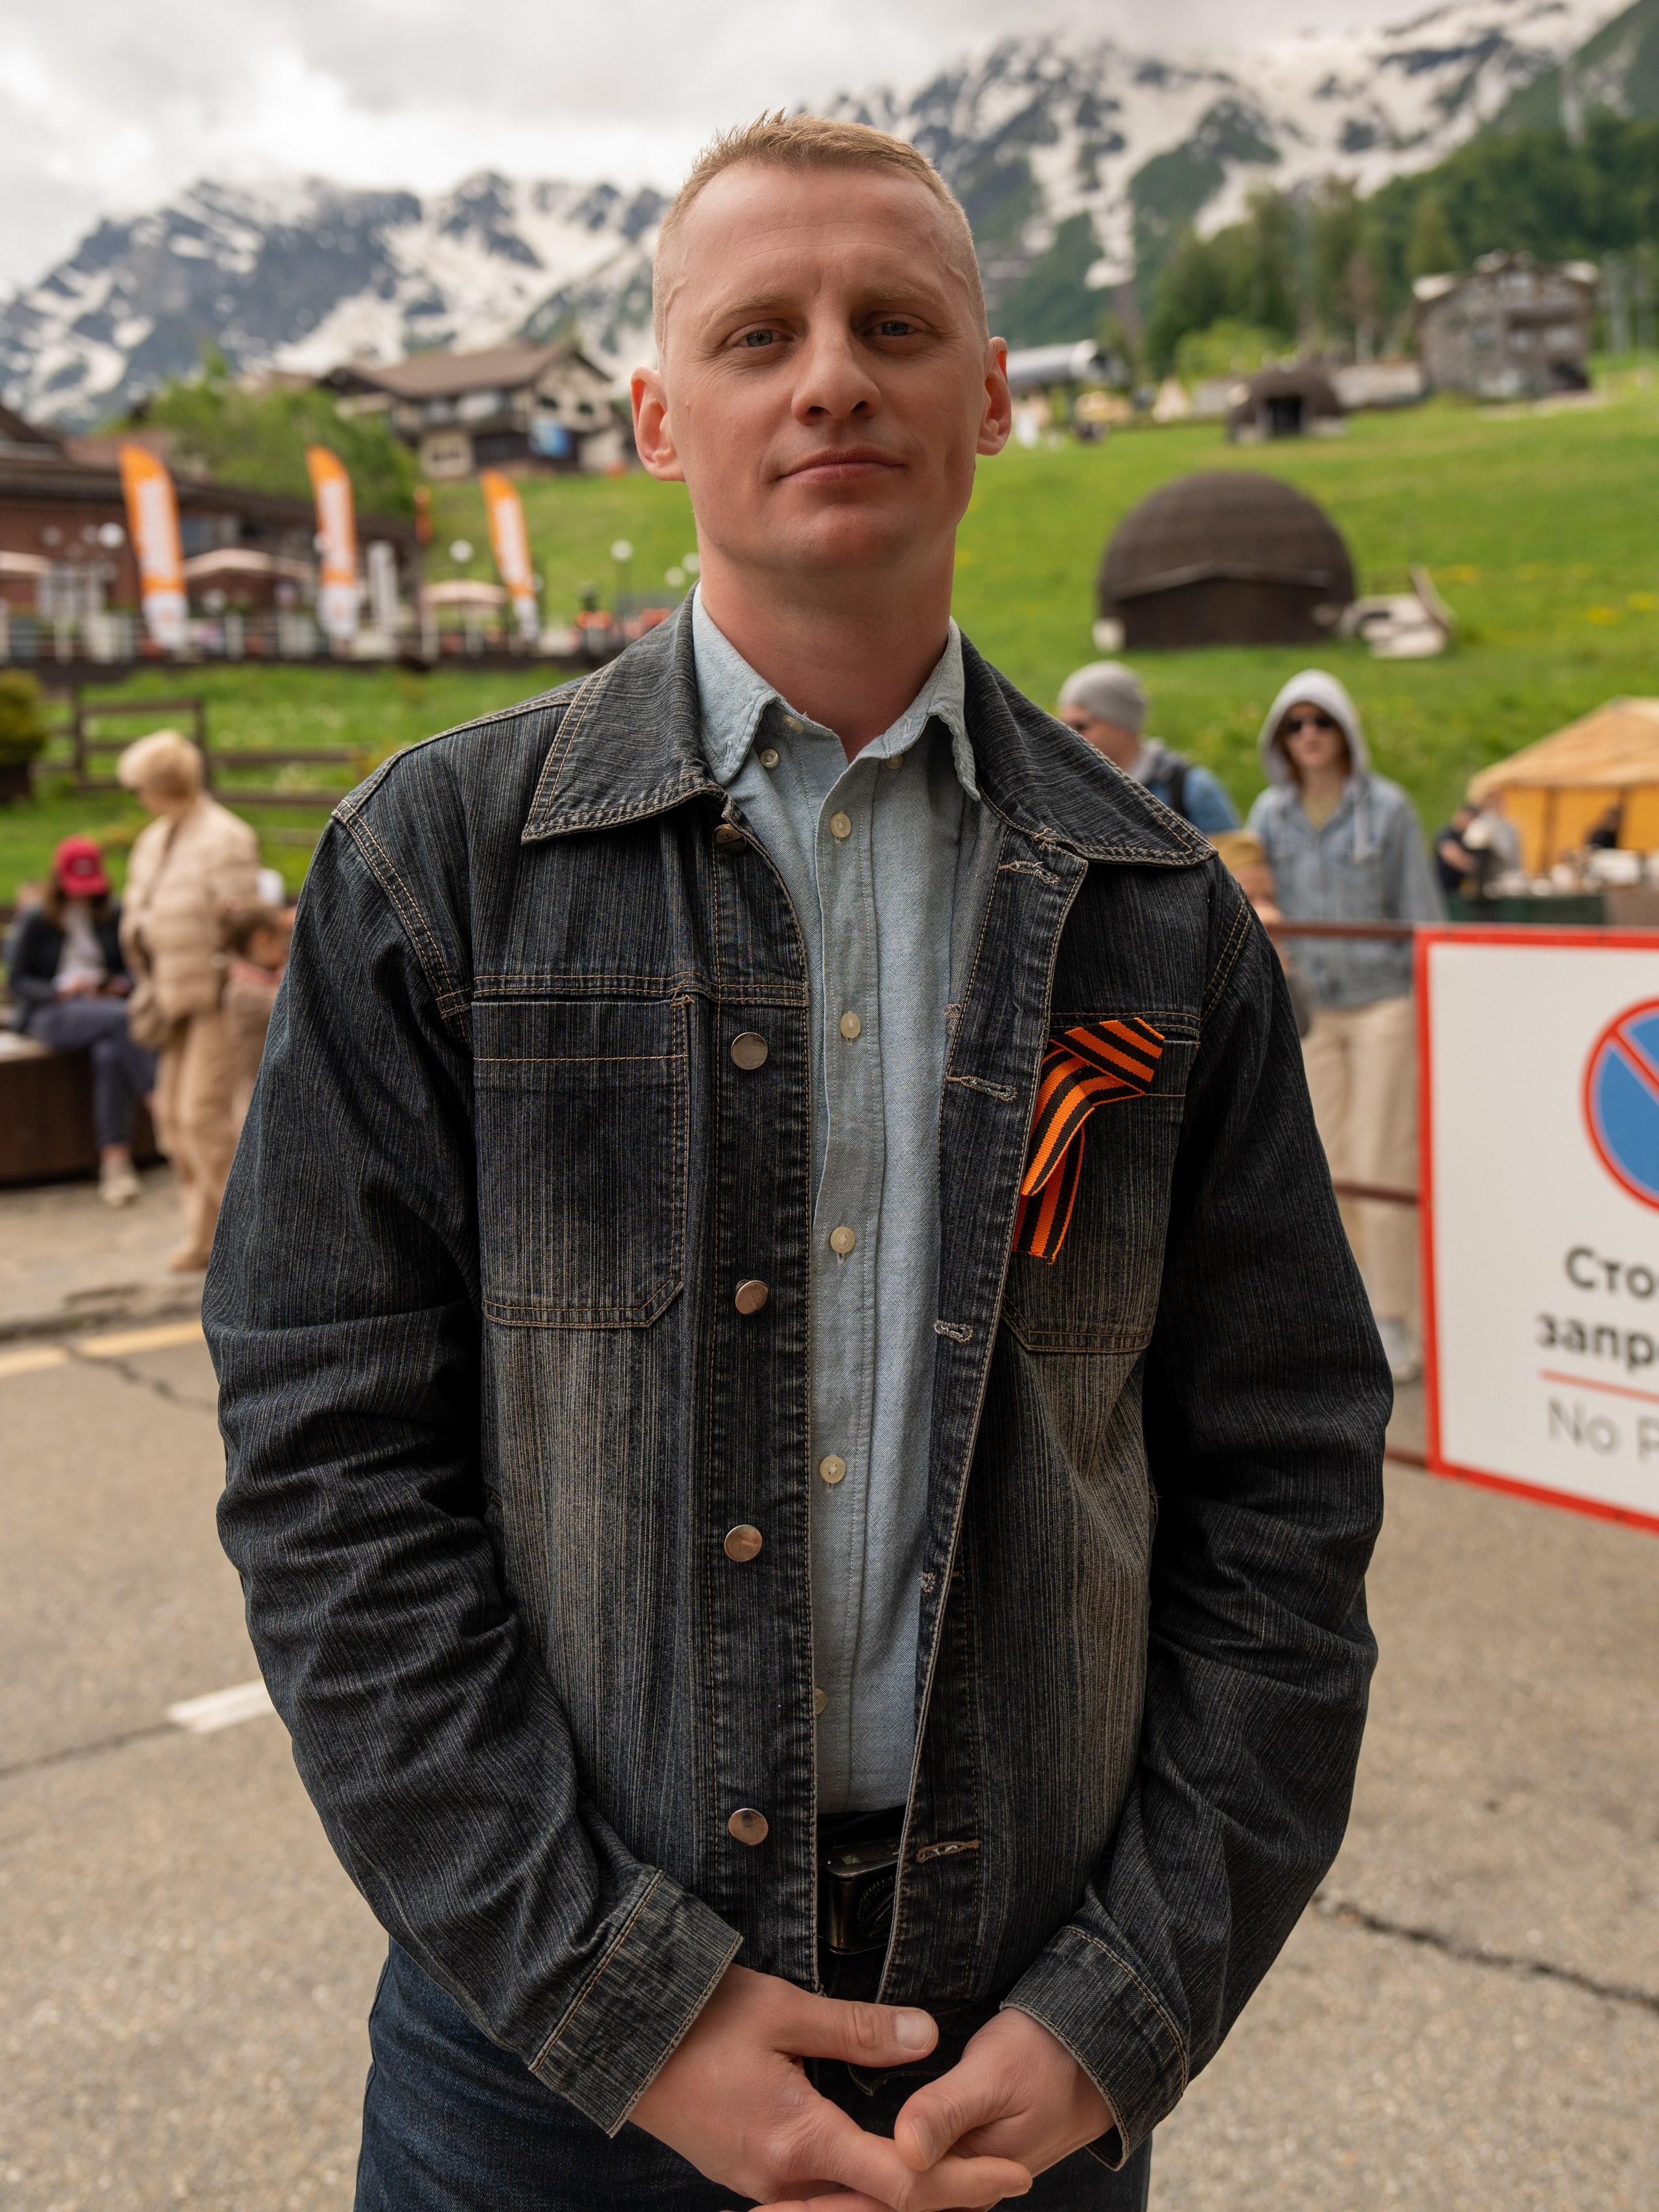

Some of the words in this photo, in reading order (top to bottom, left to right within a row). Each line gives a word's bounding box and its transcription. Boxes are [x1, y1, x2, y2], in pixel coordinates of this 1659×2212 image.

[1564, 1245, 1659, 1299] Сто
[1536, 1314, 1659, 1373] запр
[1548, 1397, 1621, 1456] No
